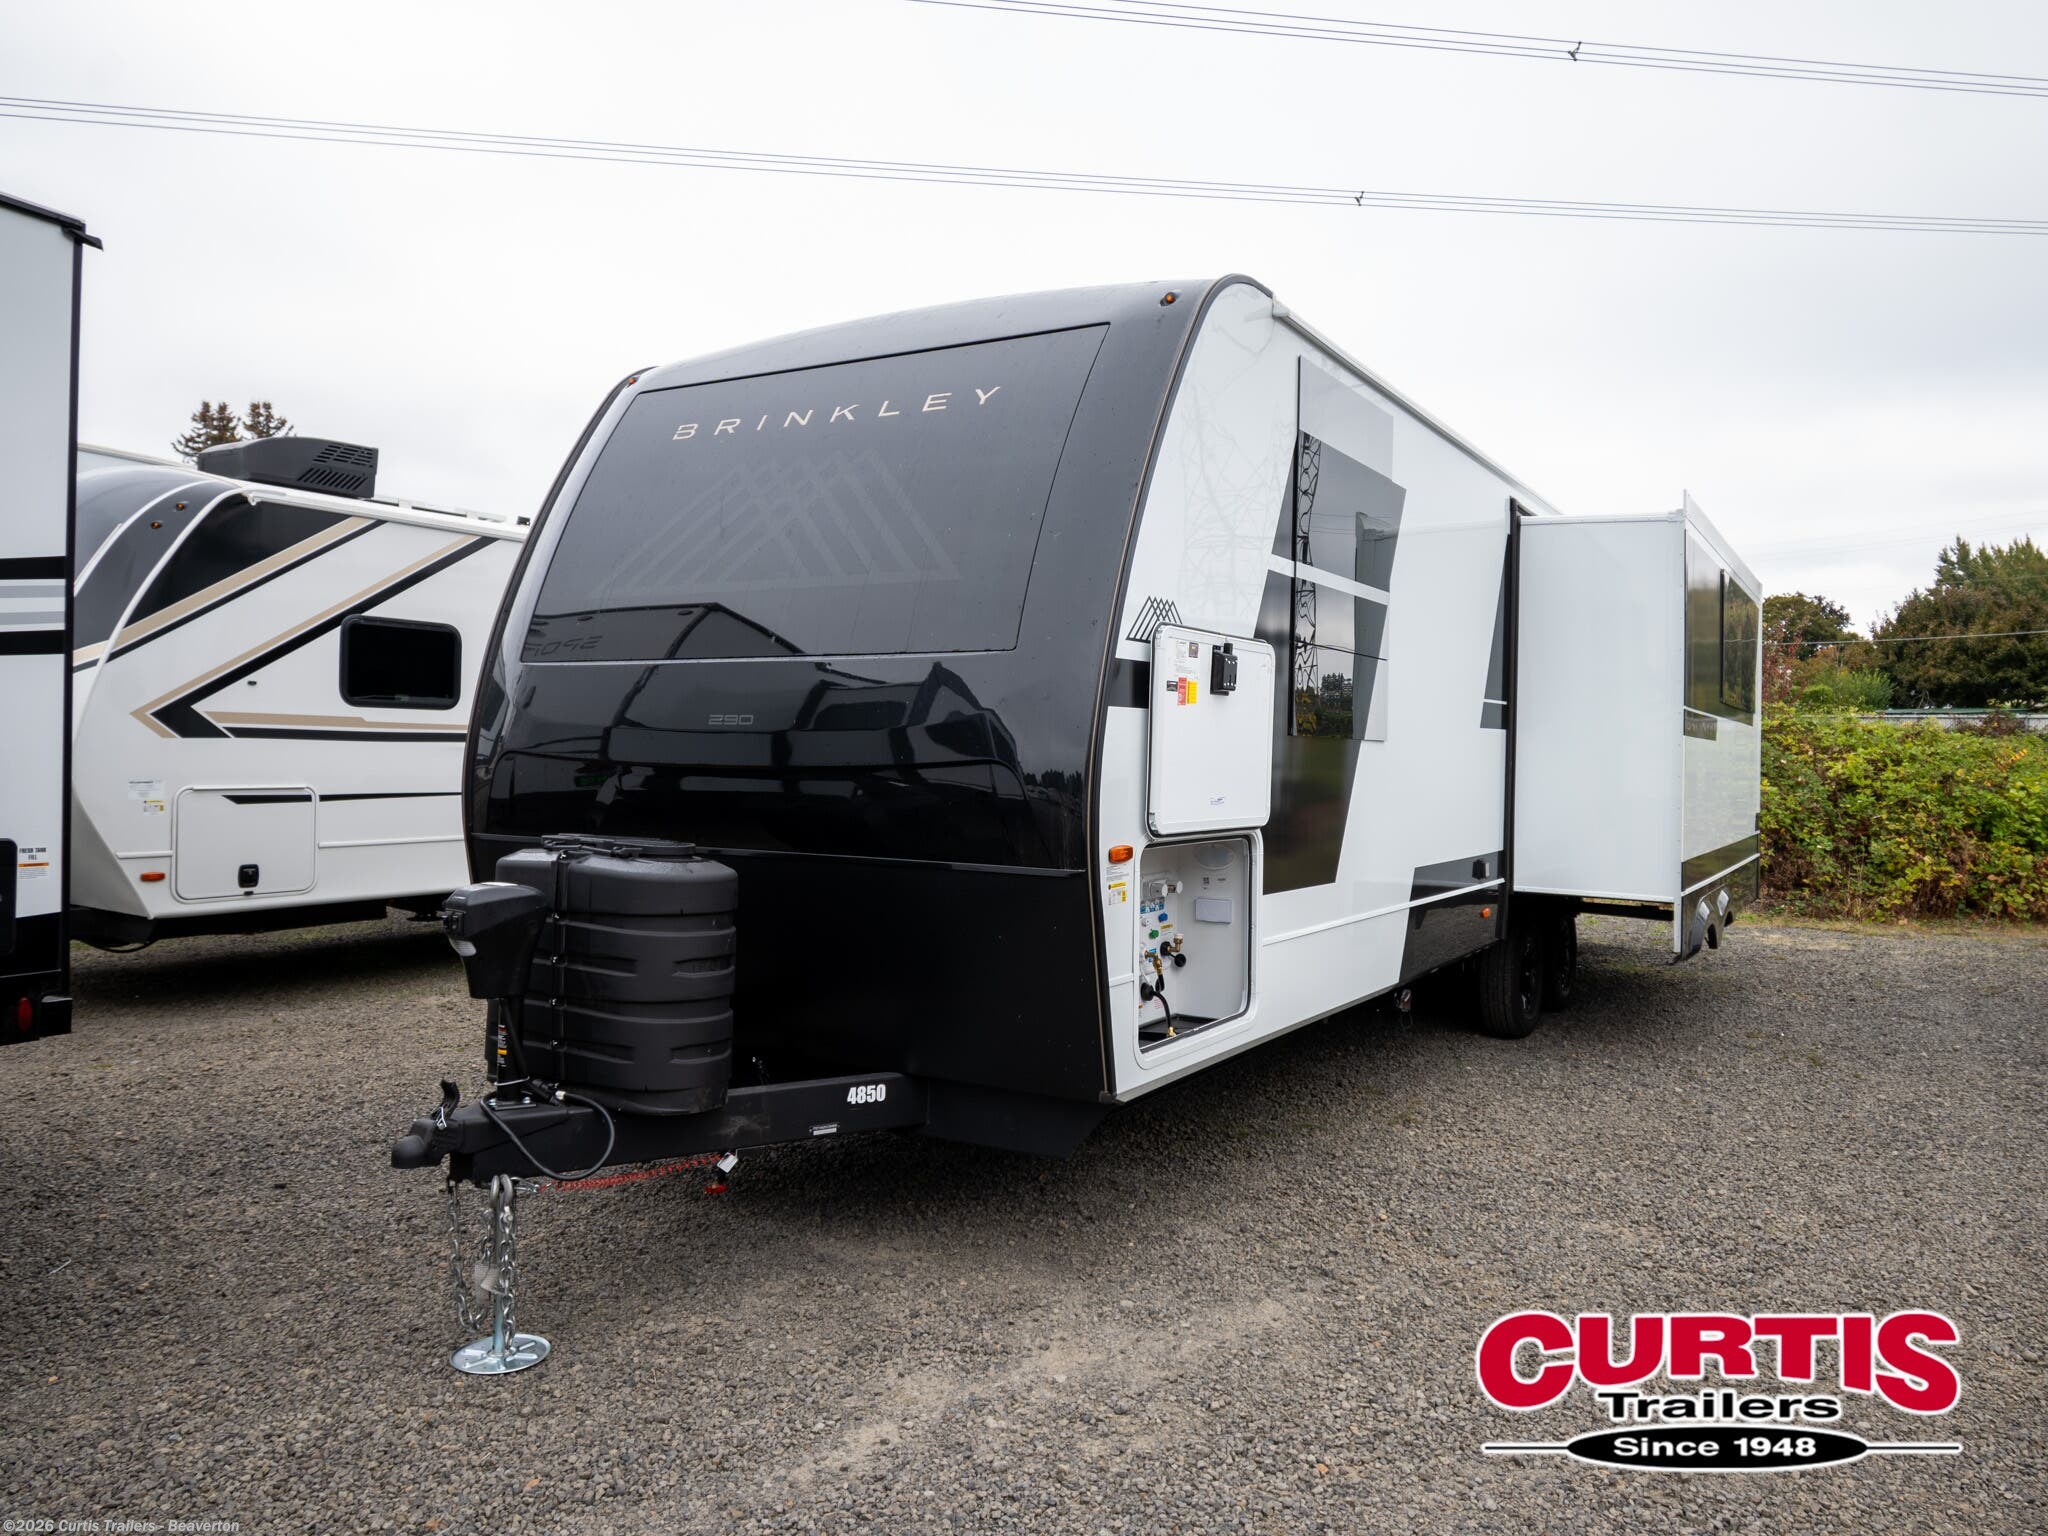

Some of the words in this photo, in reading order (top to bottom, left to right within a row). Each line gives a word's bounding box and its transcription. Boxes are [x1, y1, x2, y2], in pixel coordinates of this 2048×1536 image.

[672, 386, 1001, 440] BRINKLEY
[708, 714, 754, 725] 290
[846, 1083, 887, 1105] 4850
